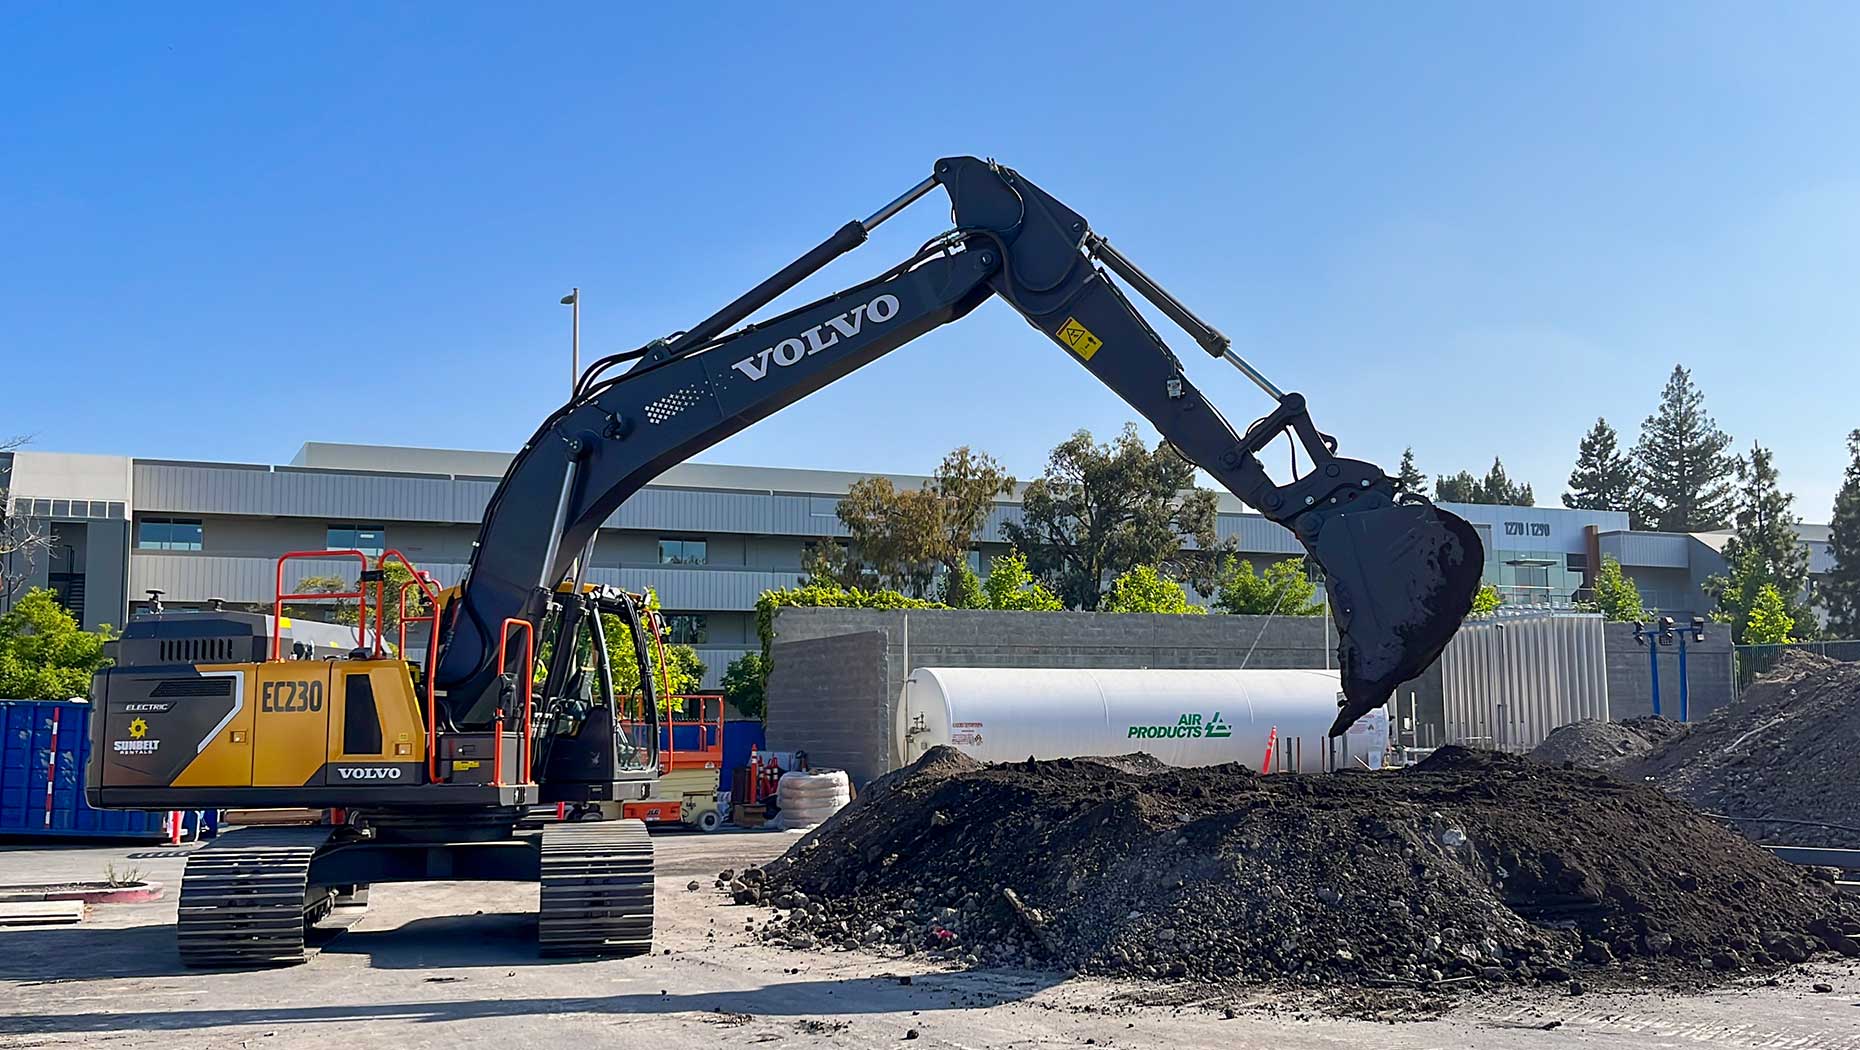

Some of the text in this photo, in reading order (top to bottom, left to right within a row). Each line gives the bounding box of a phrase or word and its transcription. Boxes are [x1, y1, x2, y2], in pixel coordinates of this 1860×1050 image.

[731, 294, 900, 381] VOLVO
[1503, 521, 1524, 536] 1270
[262, 680, 323, 712] EC230
[125, 703, 168, 711] ELECTRIC
[1178, 714, 1202, 725] AIR
[1127, 726, 1202, 738] PRODUCTS
[113, 740, 160, 751] SUNBELT
[337, 768, 401, 779] VOLVO
